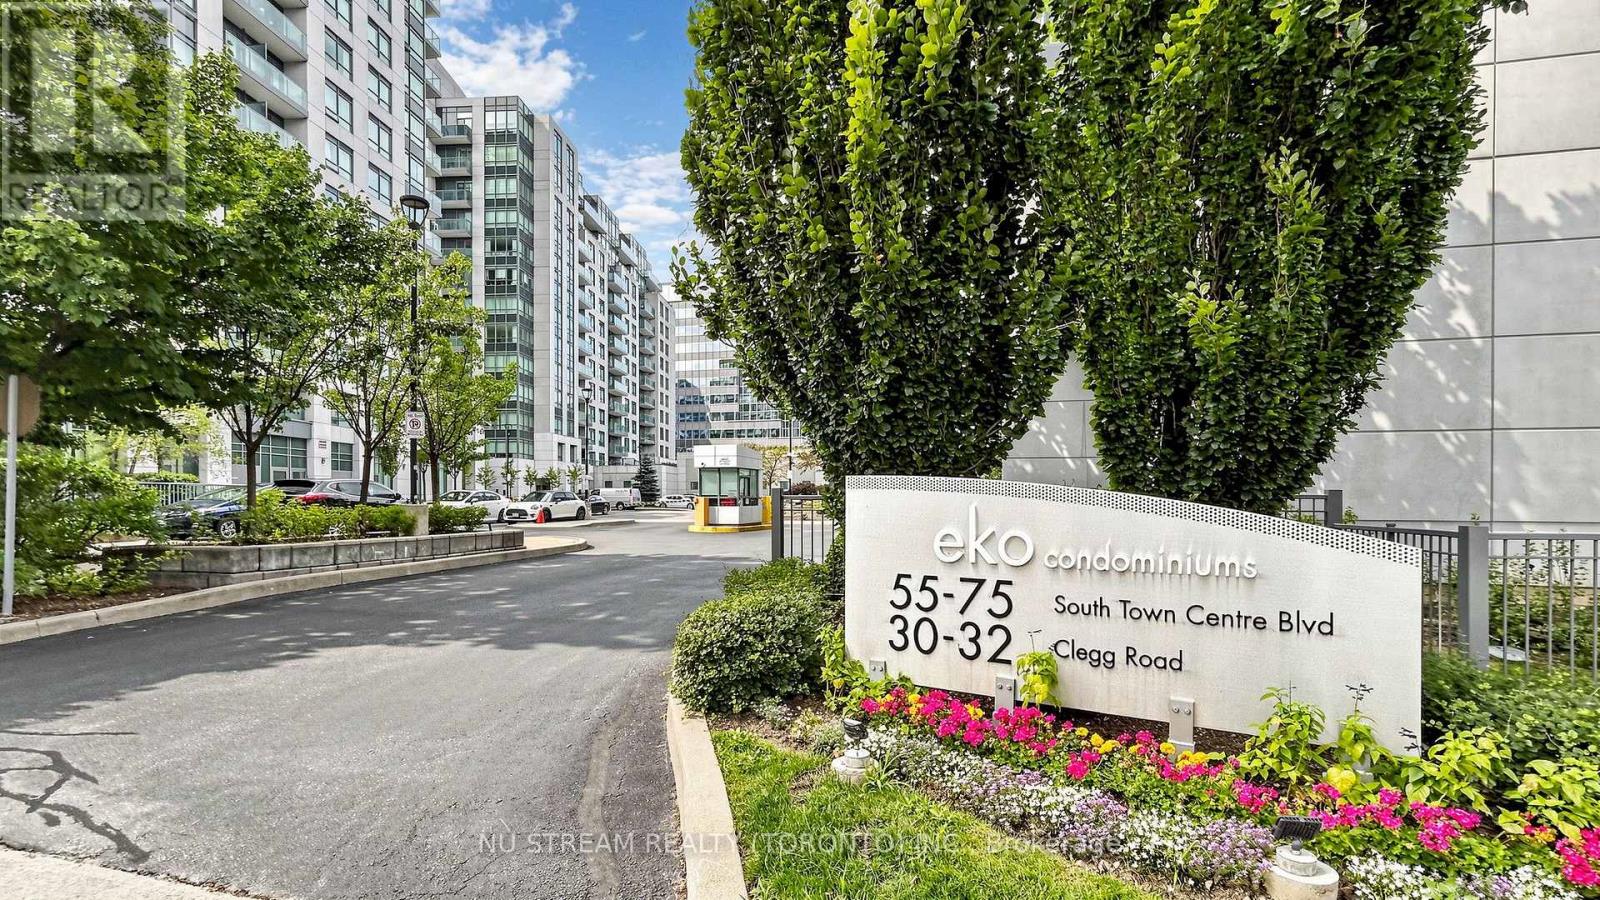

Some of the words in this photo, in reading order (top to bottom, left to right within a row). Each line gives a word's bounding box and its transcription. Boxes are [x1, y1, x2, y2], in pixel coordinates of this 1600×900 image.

[933, 502, 1034, 567] eko
[1043, 537, 1258, 579] condominiums
[889, 573, 1014, 619] 55-75
[1054, 595, 1111, 619] South
[1119, 599, 1176, 624] Town
[1186, 604, 1267, 630] Centre
[1279, 610, 1334, 636] Blvd
[888, 614, 1013, 665] 30-32
[1054, 639, 1116, 669] Clegg
[1125, 646, 1183, 672] Road
